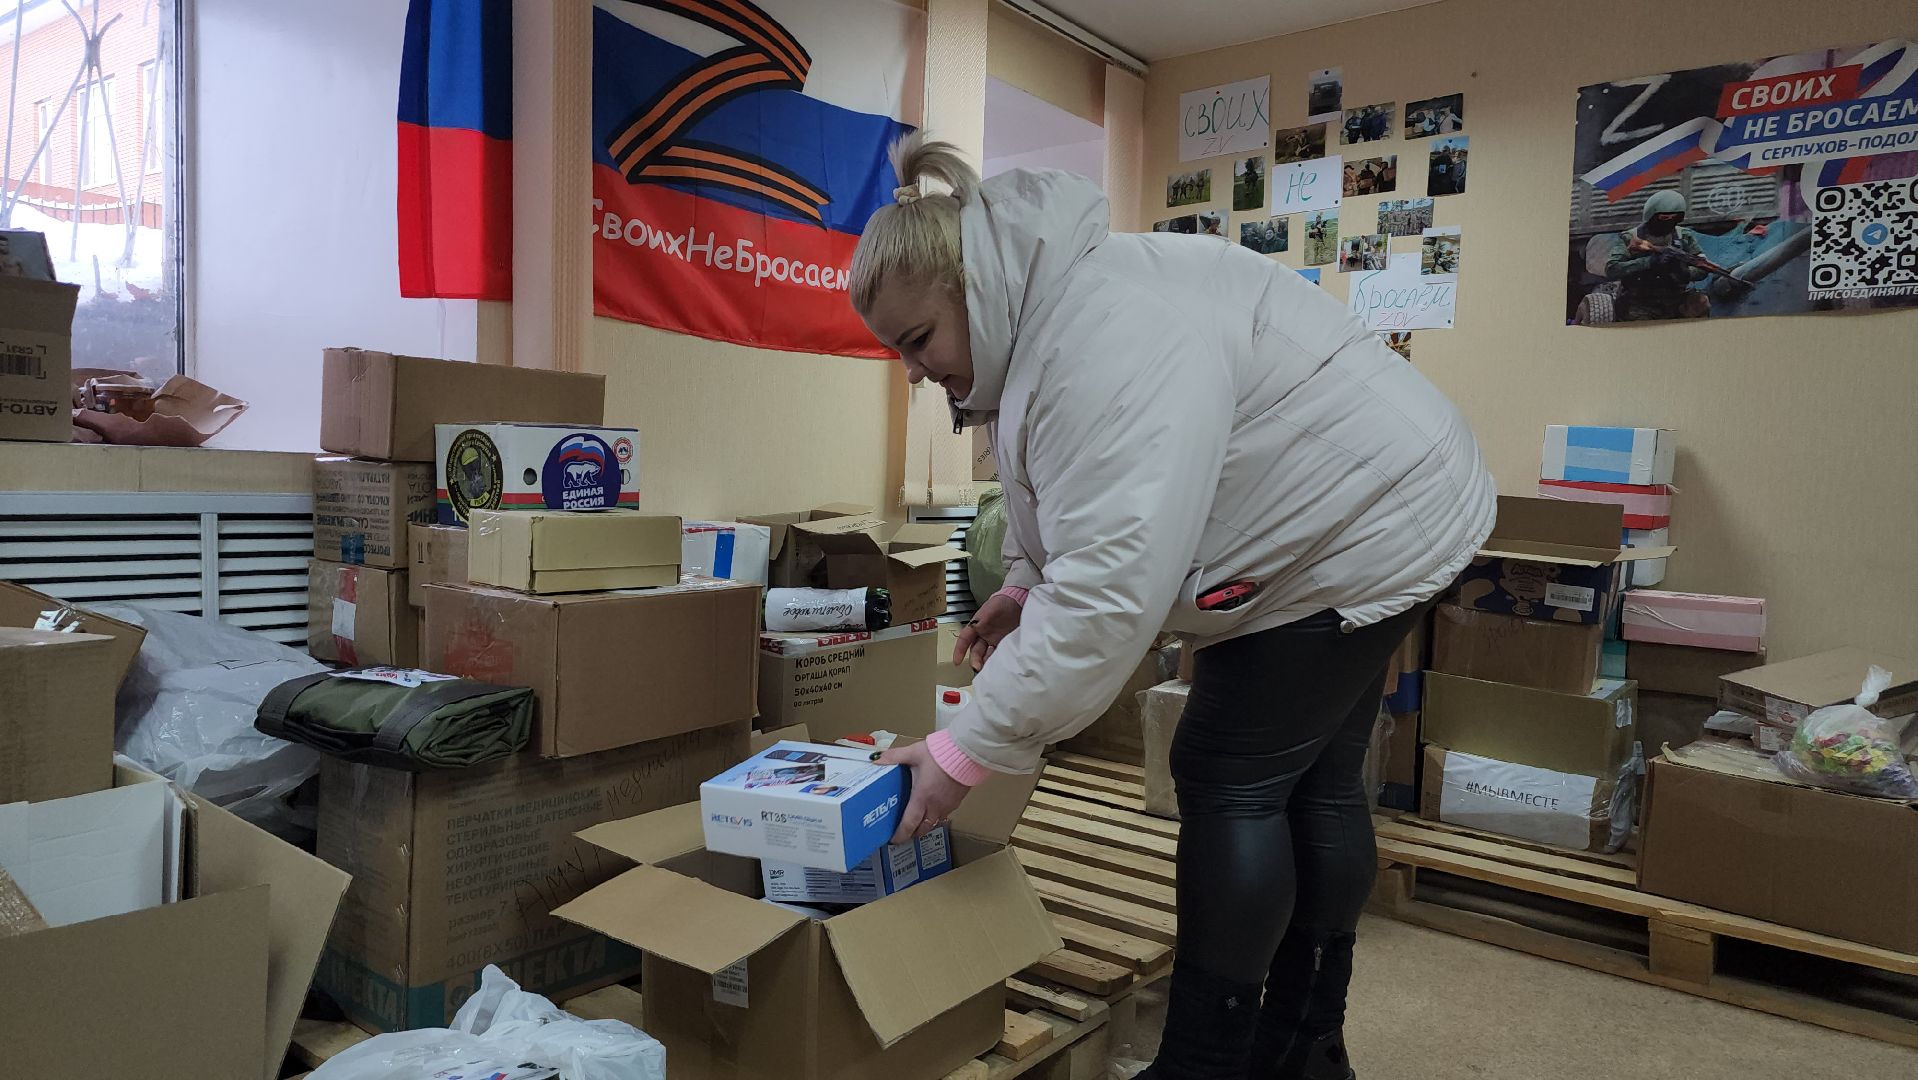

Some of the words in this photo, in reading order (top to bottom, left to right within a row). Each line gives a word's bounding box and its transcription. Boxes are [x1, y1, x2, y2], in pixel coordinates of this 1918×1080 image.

[1731, 73, 1837, 111] СВОИХ
[1184, 87, 1269, 138] СВОИХ
[1743, 116, 1781, 140] НЕ
[1786, 98, 1918, 135] БРОСАЕМ
[562, 486, 604, 500] ЕДИНАЯ
[563, 496, 605, 510] РОССИЯ
[795, 655, 826, 669] КОРОБ
[827, 645, 865, 663] СРЕДНИЙ
[446, 817, 534, 845] СТЕРИЛЬНЫЕ
[536, 800, 602, 825] ЛАТЕКСНЫЕ
[447, 807, 513, 829] ПЕРЧАТКИ
[515, 786, 601, 815] МЕДИЦИНСКИЕ
[446, 828, 541, 859] ОДНОРАЗОВЫЕ
[447, 843, 550, 875] ХИРУРГИЧЕСКИЕ
